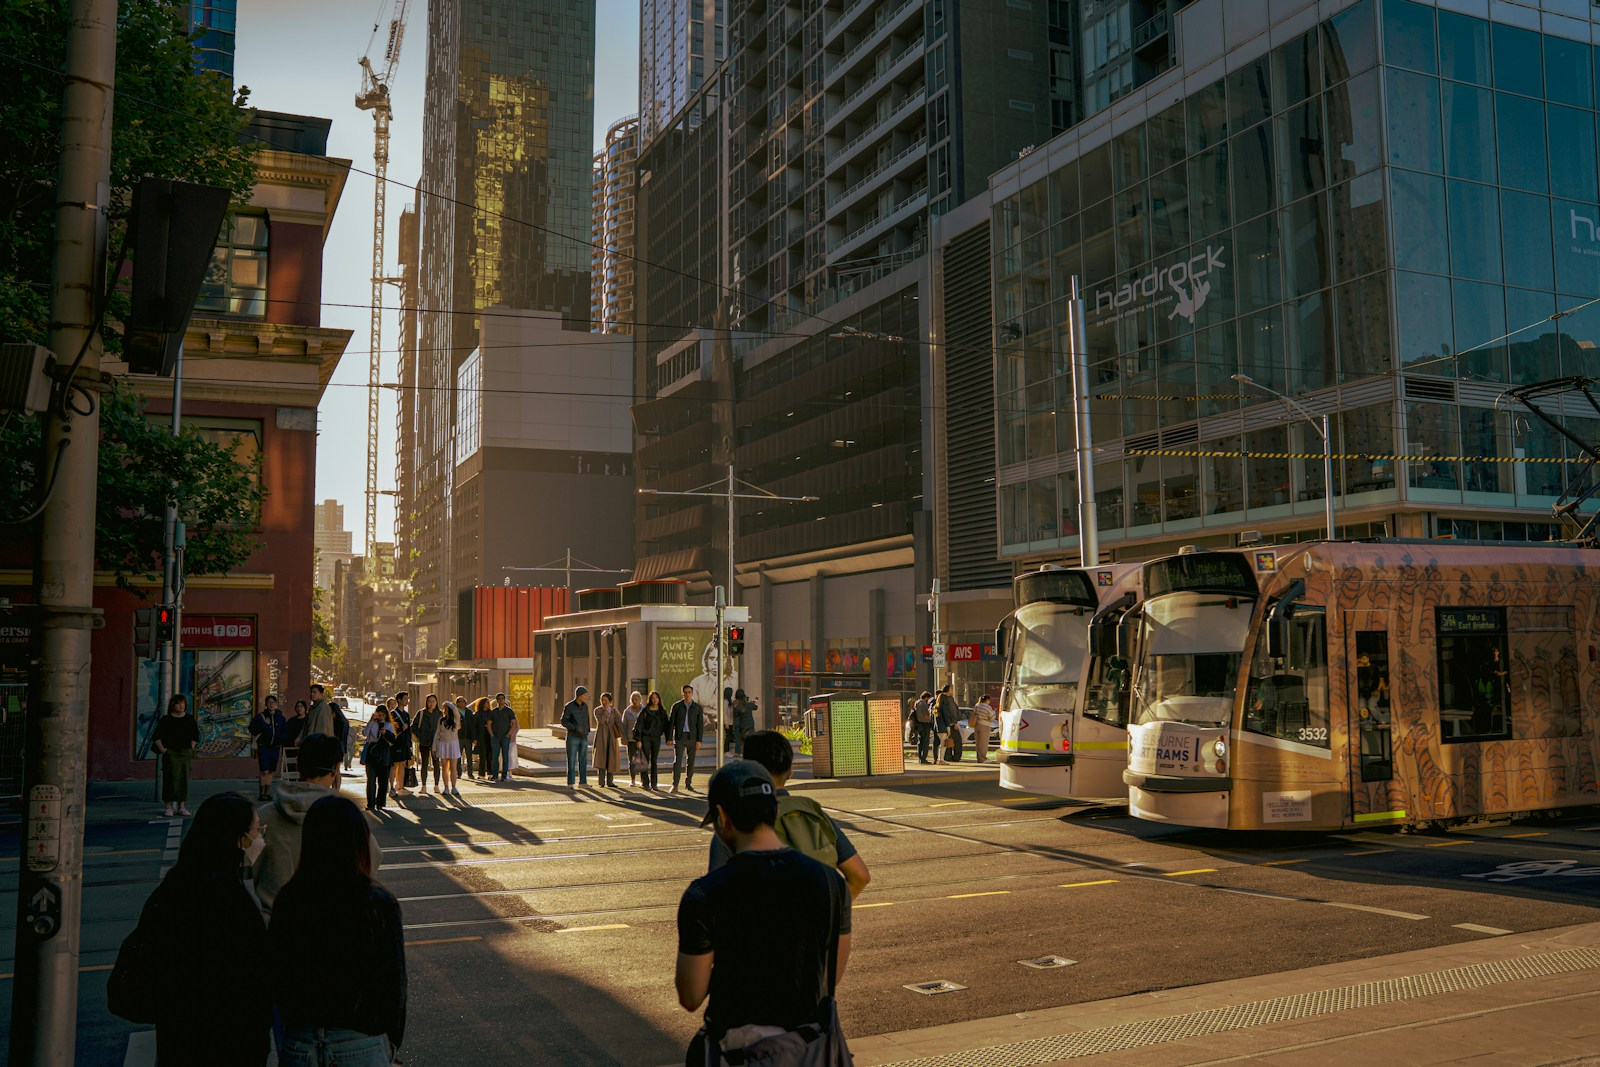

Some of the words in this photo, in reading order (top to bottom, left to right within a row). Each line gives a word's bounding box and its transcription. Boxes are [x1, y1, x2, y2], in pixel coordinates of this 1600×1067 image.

[1095, 245, 1226, 315] hardrock
[1146, 295, 1173, 309] experience
[181, 627, 200, 635] WITH
[201, 627, 212, 635] US
[661, 642, 695, 651] AUNTY
[954, 646, 973, 659] AVIS
[661, 651, 694, 661] ANNIE
[1299, 727, 1327, 741] 3532
[1143, 734, 1190, 749] ELBOURNE
[1152, 747, 1189, 761] TRAMS
